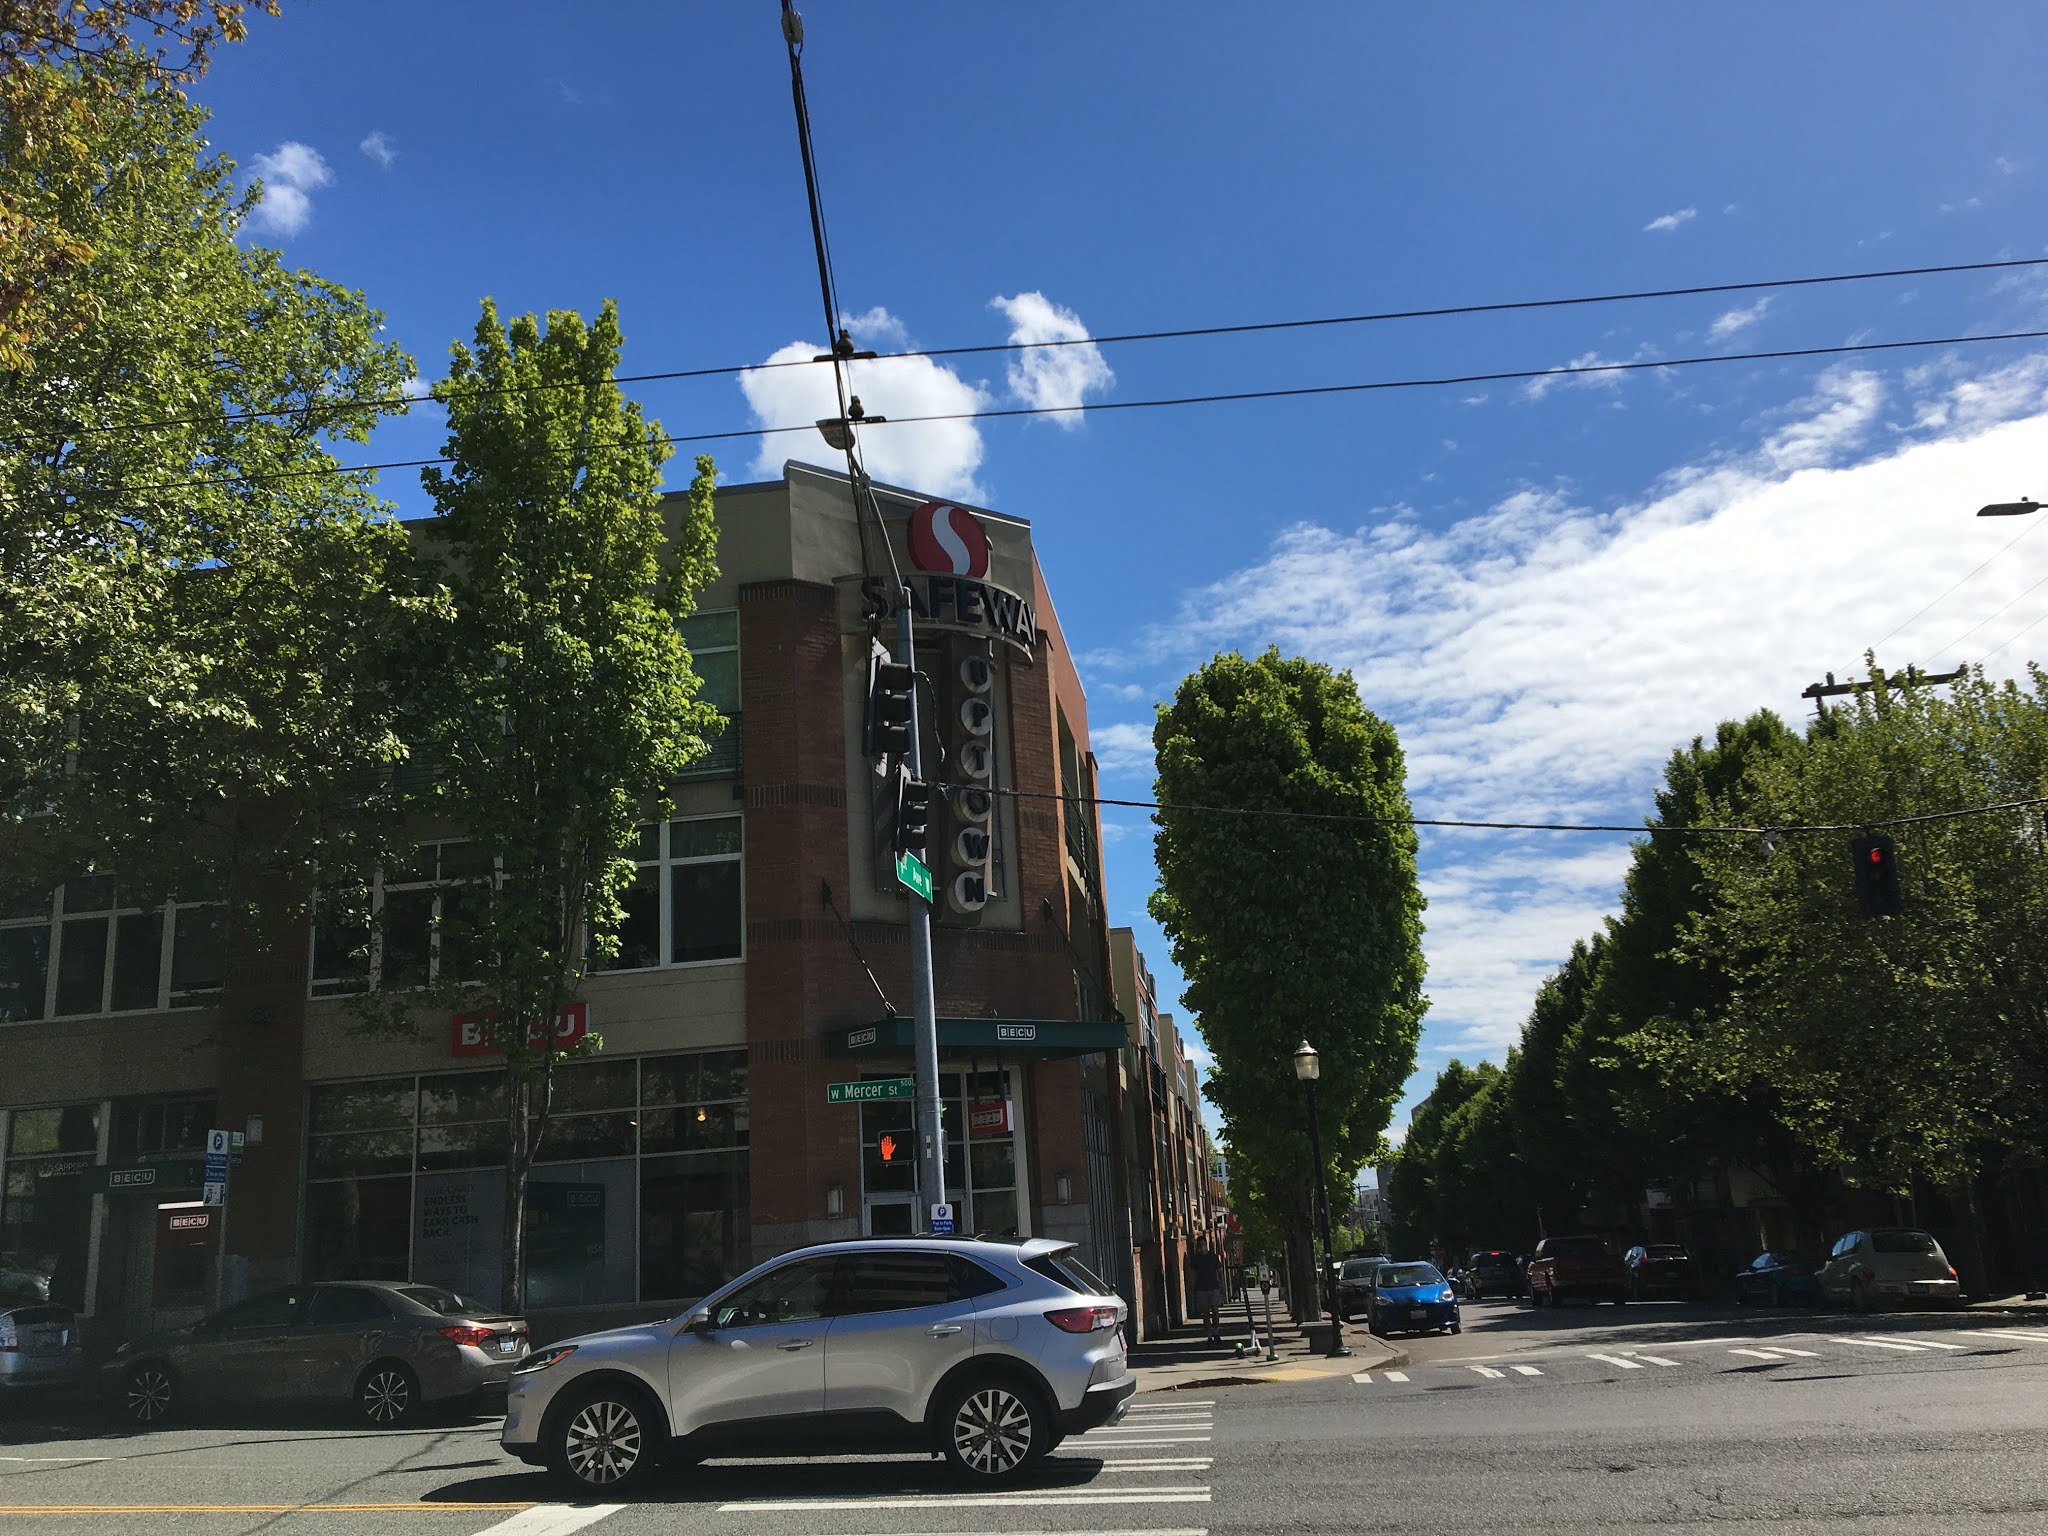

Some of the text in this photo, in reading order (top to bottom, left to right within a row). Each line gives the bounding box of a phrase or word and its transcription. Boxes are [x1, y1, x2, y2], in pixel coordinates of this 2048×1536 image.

[862, 576, 1037, 646] SAFEWAY
[963, 660, 990, 904] UPTOWN
[461, 1013, 575, 1045] BU
[999, 1027, 1034, 1039] BECU
[849, 1029, 876, 1046] BECU
[845, 1084, 883, 1098] Mercer
[888, 1084, 898, 1096] St
[900, 1079, 913, 1088] 500
[113, 1171, 152, 1184] BECU
[424, 1195, 466, 1206] ENDLESS
[424, 1206, 468, 1217] WAYS TO
[172, 1215, 206, 1228] BECU
[423, 1215, 479, 1228] EARN CASH
